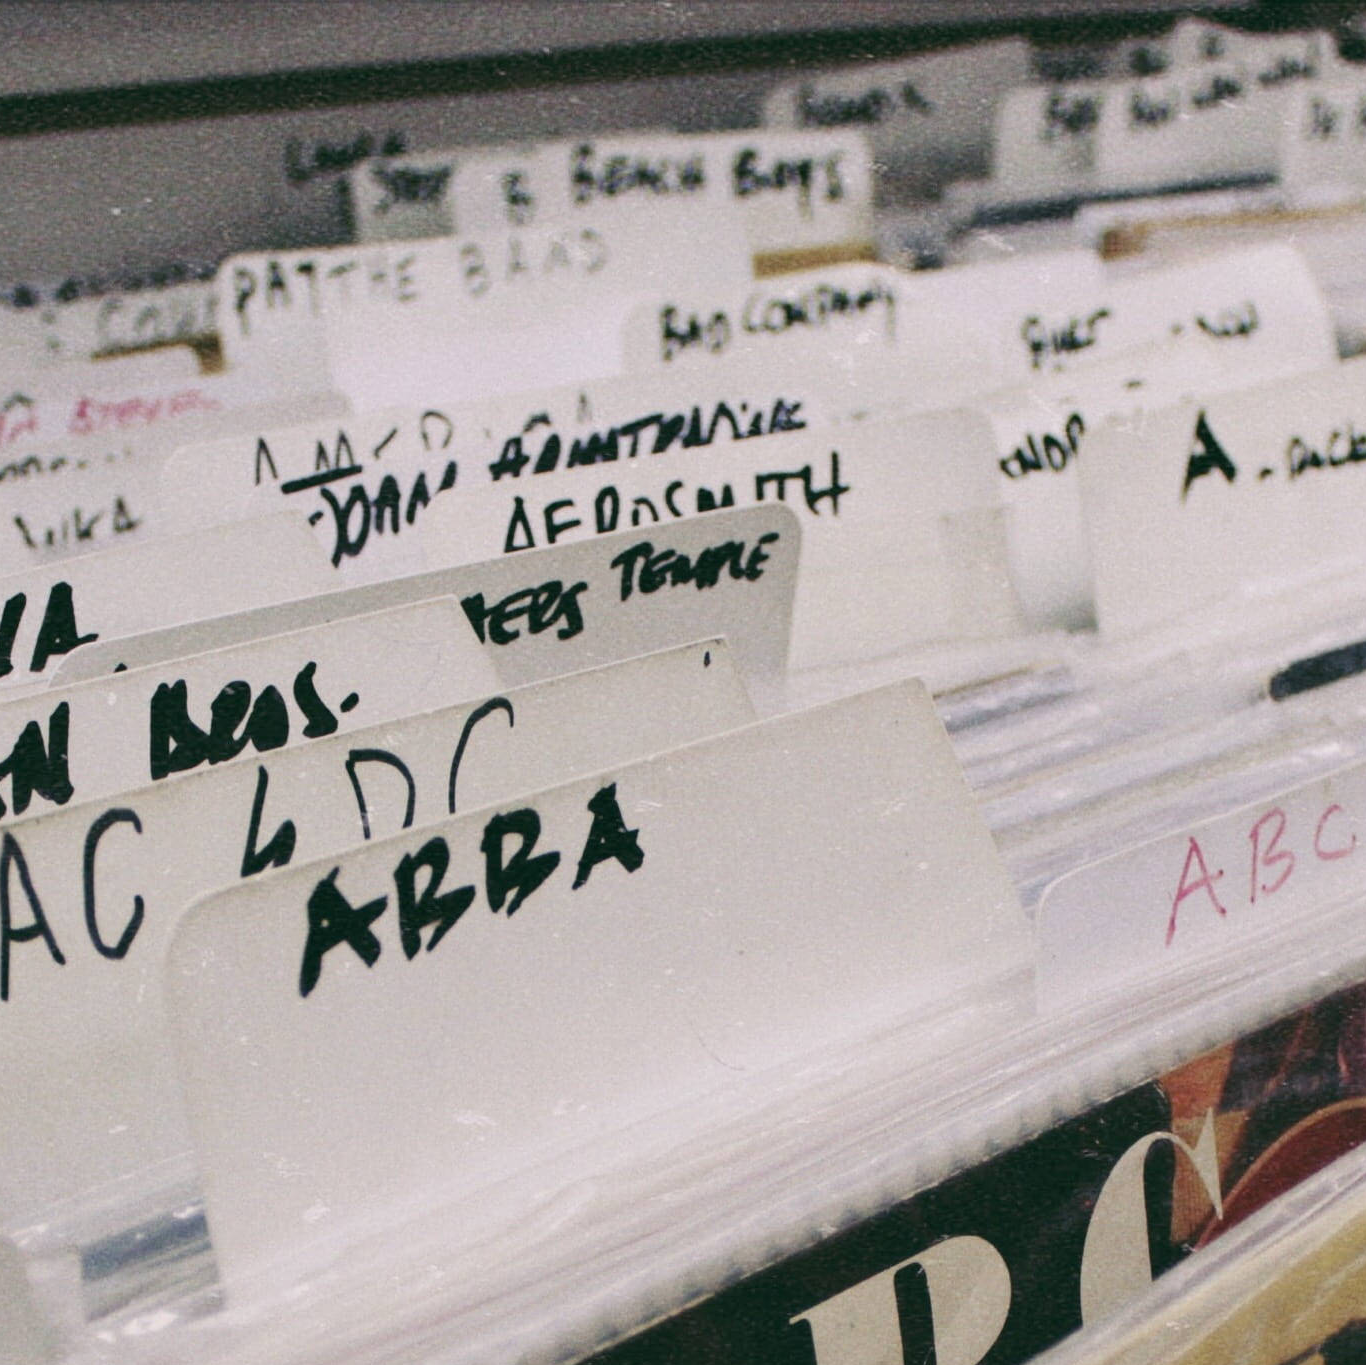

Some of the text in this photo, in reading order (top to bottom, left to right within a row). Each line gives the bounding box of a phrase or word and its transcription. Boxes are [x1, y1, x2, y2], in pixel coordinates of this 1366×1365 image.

[609, 531, 780, 602] TEMPLE
[298, 782, 646, 998] ABBA
[1164, 803, 1358, 948] ABC
